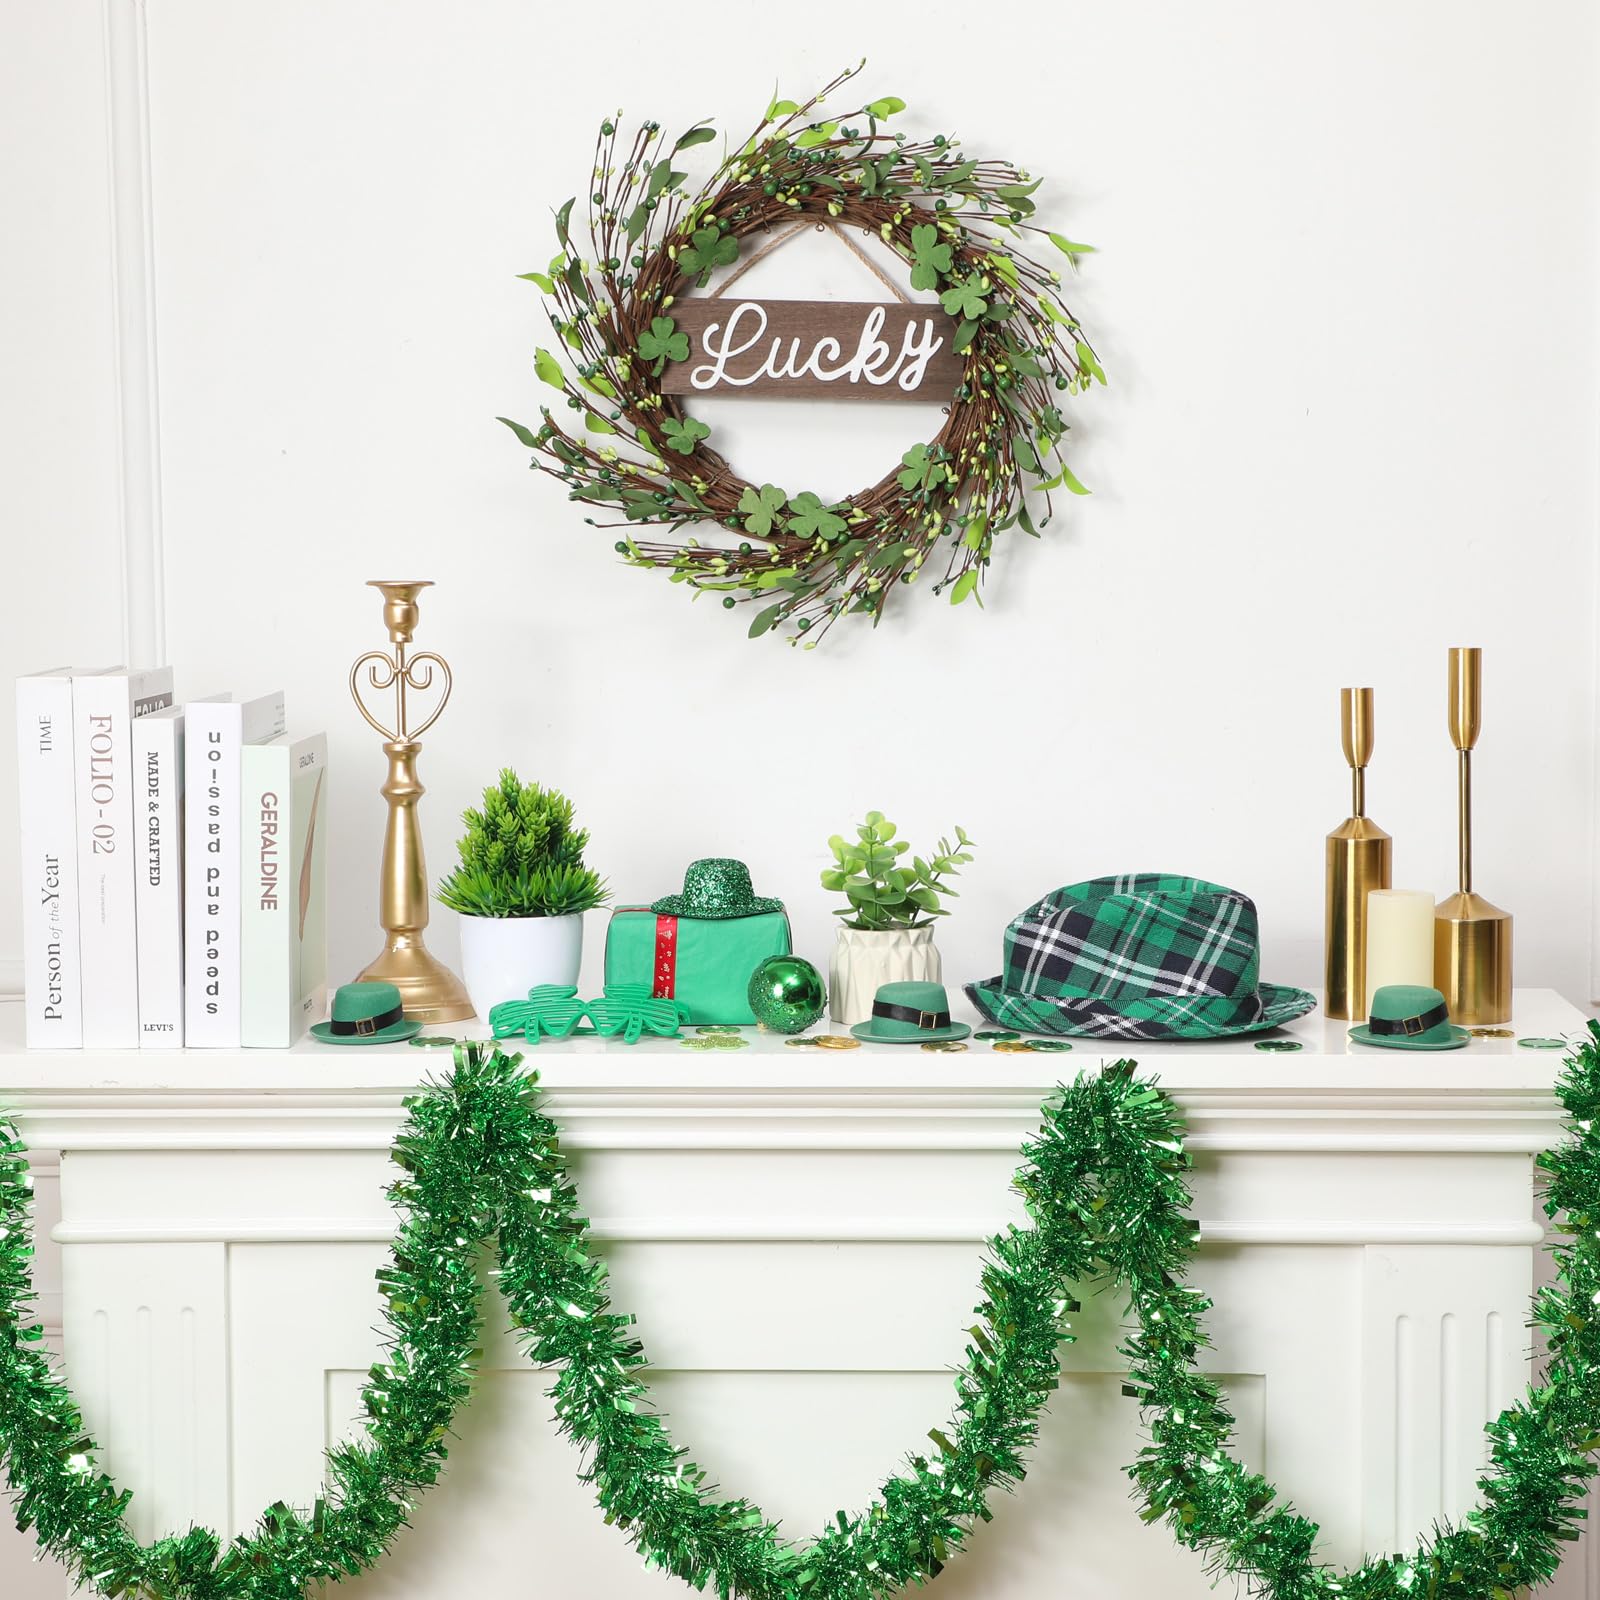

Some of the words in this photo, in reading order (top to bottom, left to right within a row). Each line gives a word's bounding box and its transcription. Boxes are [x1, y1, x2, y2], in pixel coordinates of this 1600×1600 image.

[690, 302, 944, 392] Lucky
[39, 715, 52, 754] TIME
[89, 714, 114, 805] FOLIO
[147, 751, 160, 798] MADE
[148, 801, 160, 813] &
[92, 824, 116, 854] 02
[148, 816, 161, 887] CRAFTED
[260, 791, 278, 911] GERALDINE
[41, 853, 60, 905] Year
[49, 901, 59, 922] the
[49, 925, 63, 940] of
[44, 942, 63, 1021] Person
[143, 1023, 174, 1032] LEVI'S
